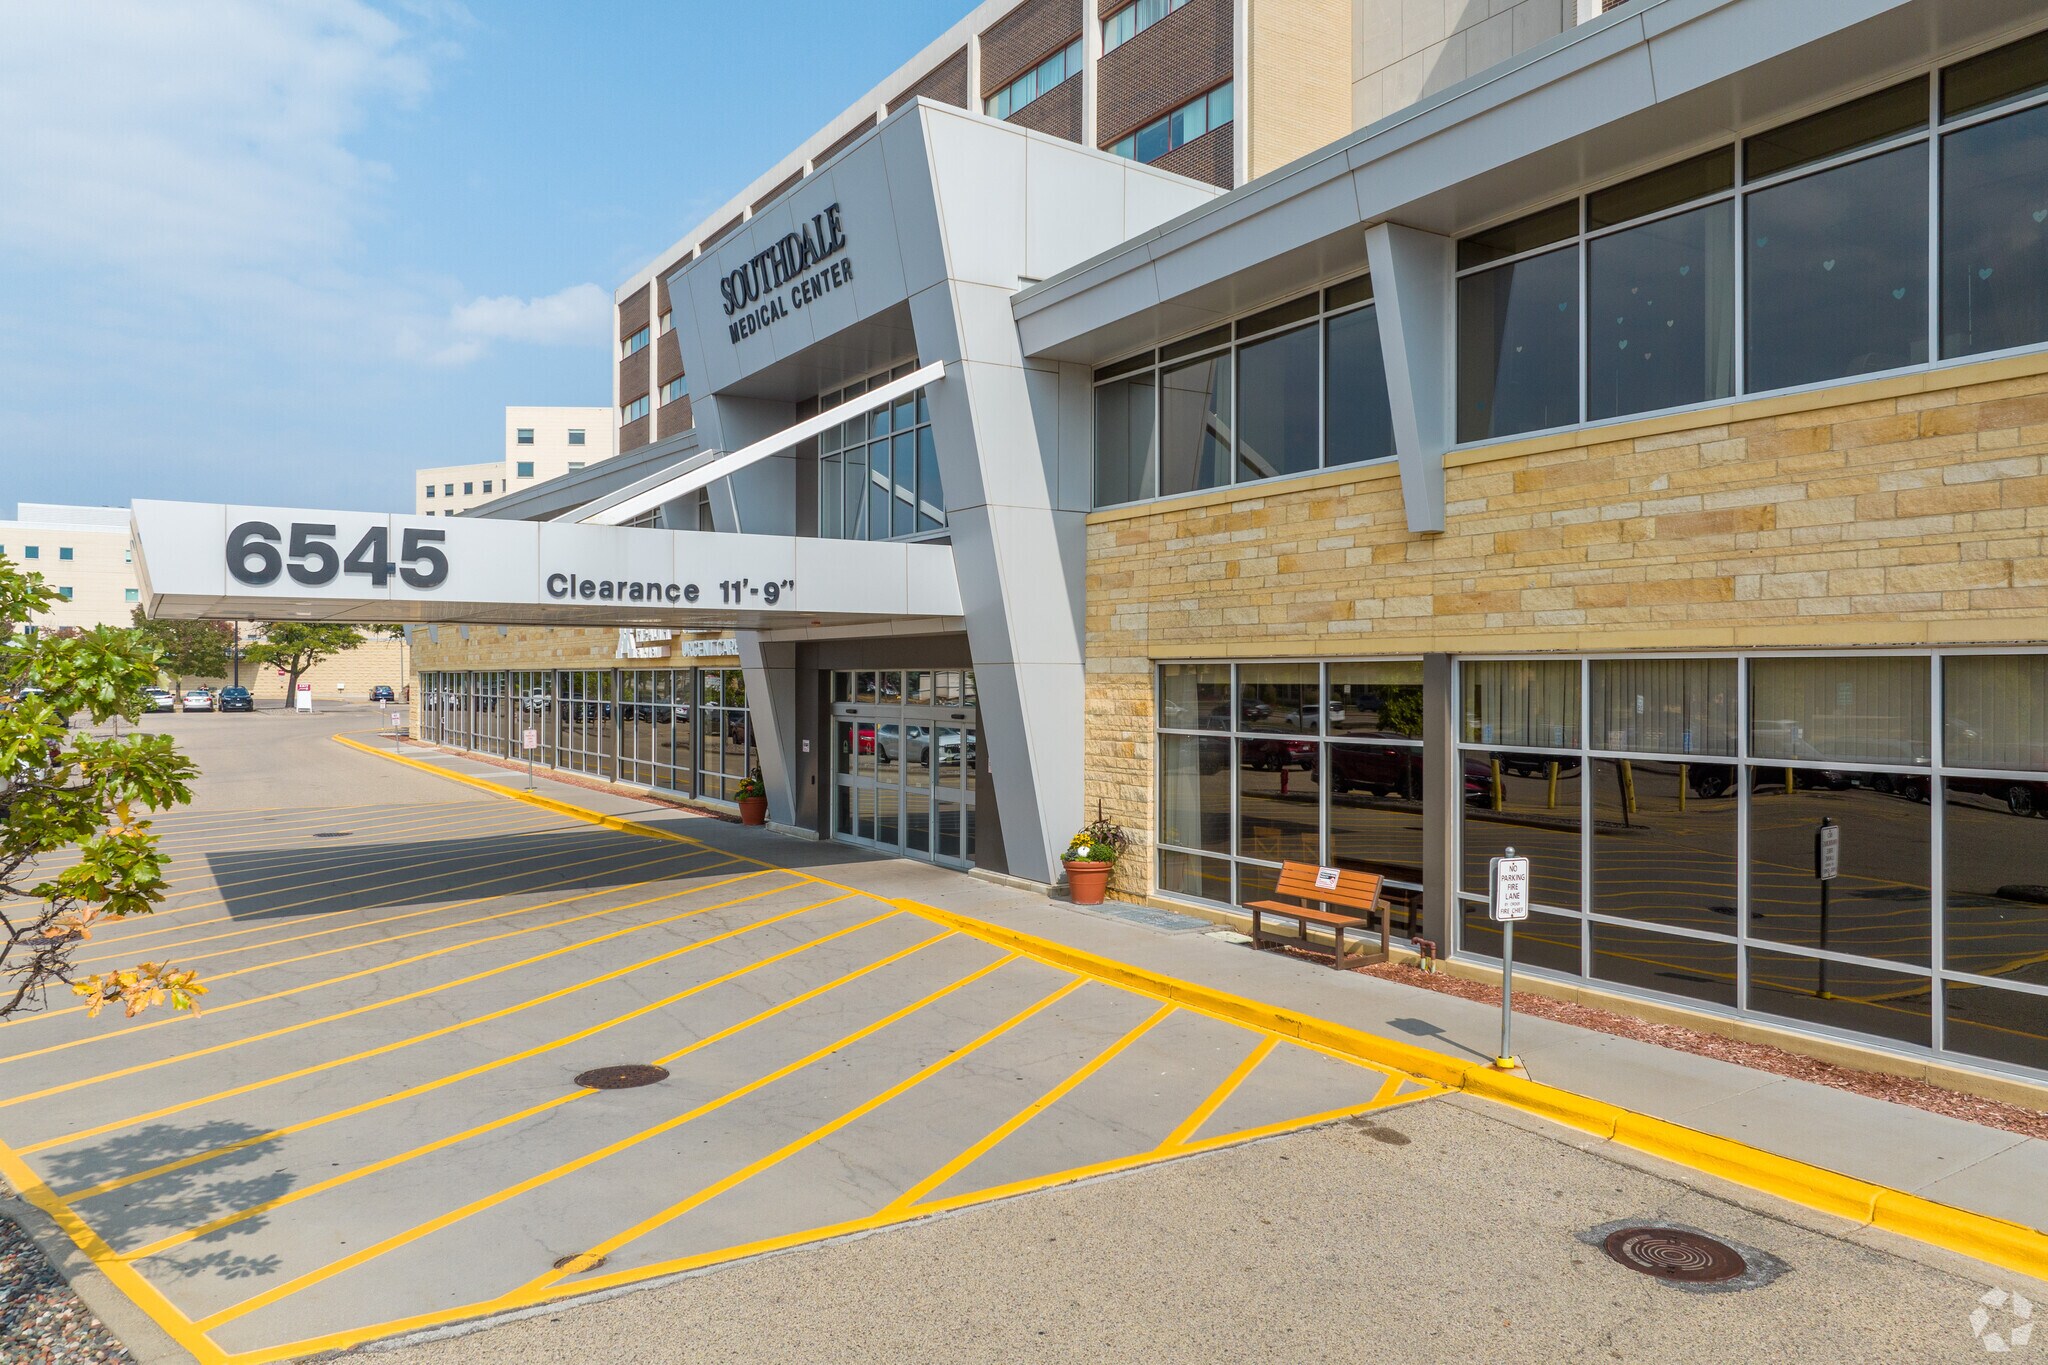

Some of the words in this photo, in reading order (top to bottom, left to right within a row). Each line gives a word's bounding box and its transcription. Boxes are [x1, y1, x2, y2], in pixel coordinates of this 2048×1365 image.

[720, 202, 846, 316] SOUTHDALE
[728, 296, 788, 345] MEDICAL
[791, 257, 854, 309] CENTER
[226, 521, 449, 589] 6545
[546, 573, 700, 602] Clearance
